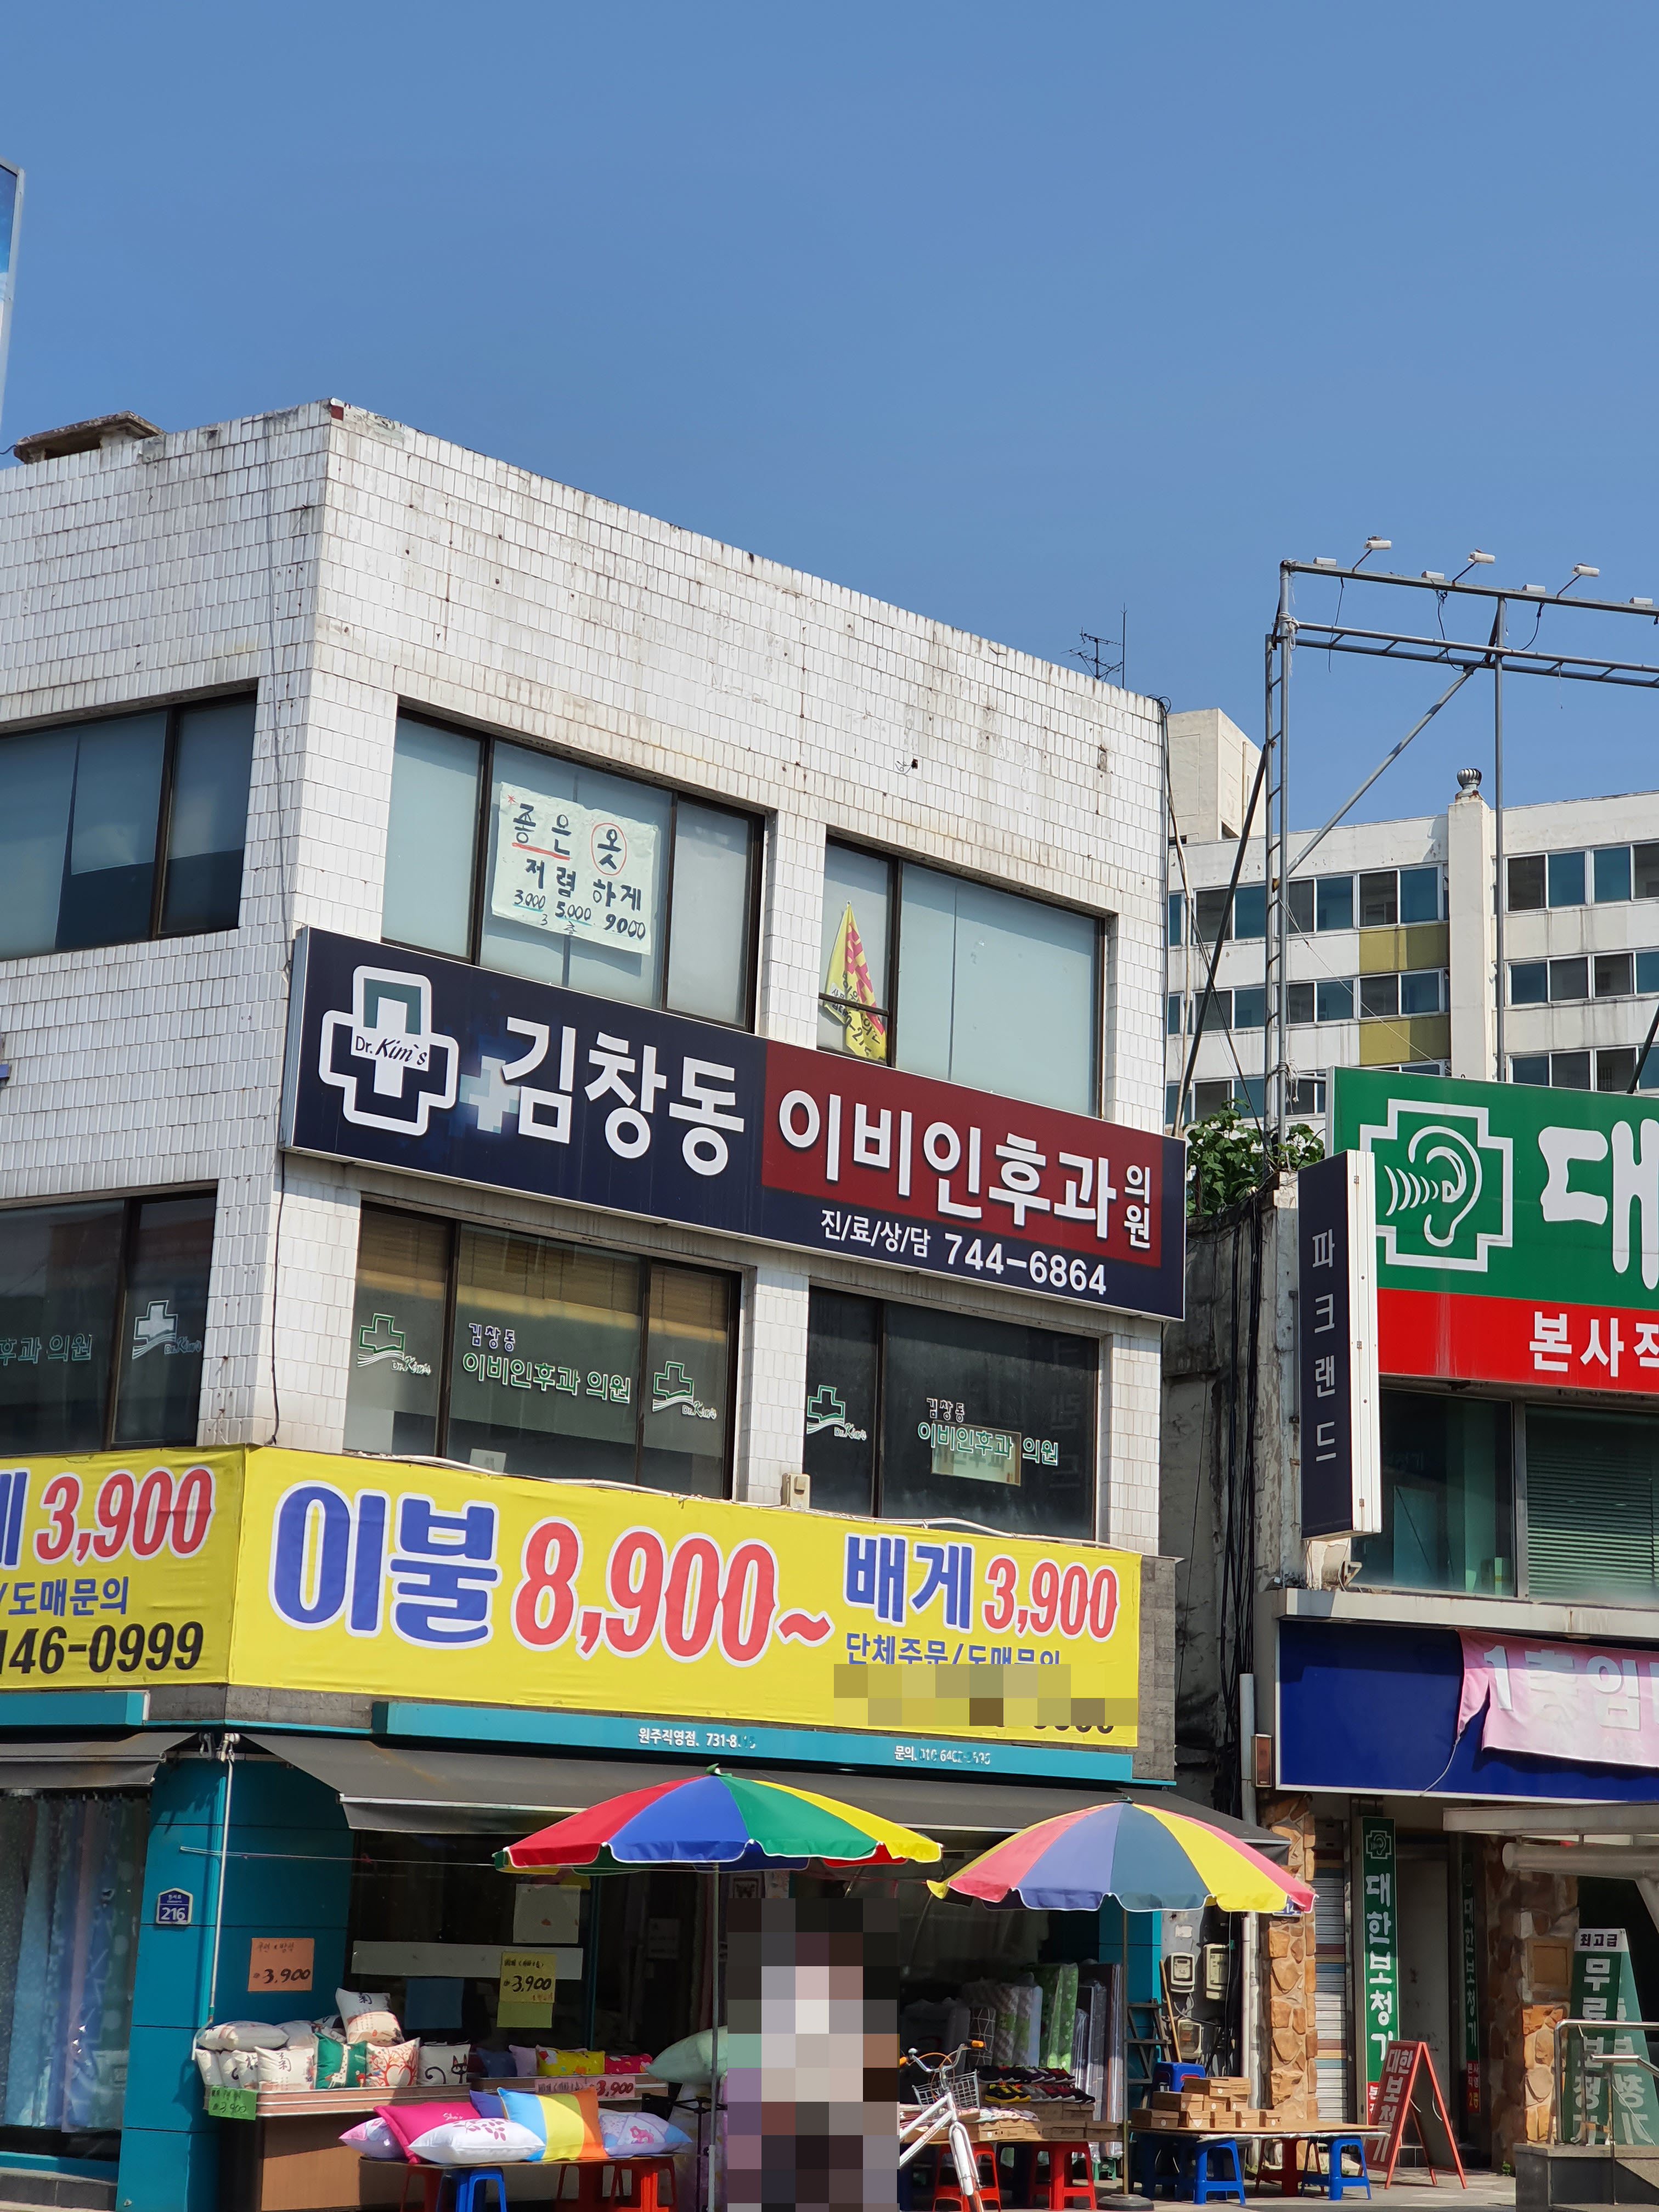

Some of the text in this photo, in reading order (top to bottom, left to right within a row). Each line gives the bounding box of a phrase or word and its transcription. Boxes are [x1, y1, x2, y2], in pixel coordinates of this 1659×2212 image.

[512, 803, 622, 870] 좋은 옷
[502, 1017, 1117, 1239] 김창동 이비인후과
[821, 1209, 1107, 1295] 진/료/상/담 744-6864
[47, 1334, 92, 1362] 의원
[469, 1323, 516, 1351] 김창동
[1312, 1228, 1336, 1462] 파크랜드
[462, 1352, 631, 1404] 이비인후과 의원
[926, 1397, 966, 1423] 김창동
[917, 1422, 1059, 1466] 이비인후과 의원
[35, 1465, 215, 1566] 3,900
[269, 1480, 501, 1649] 이불
[843, 1533, 974, 1633] 배게
[982, 1554, 1119, 1642] 3,900
[161, 1906, 185, 1921] 216
[1580, 1933, 1617, 1948] 최고급
[1365, 1872, 1394, 2062] 대한보청기
[1385, 2049, 1414, 2074] 대한
